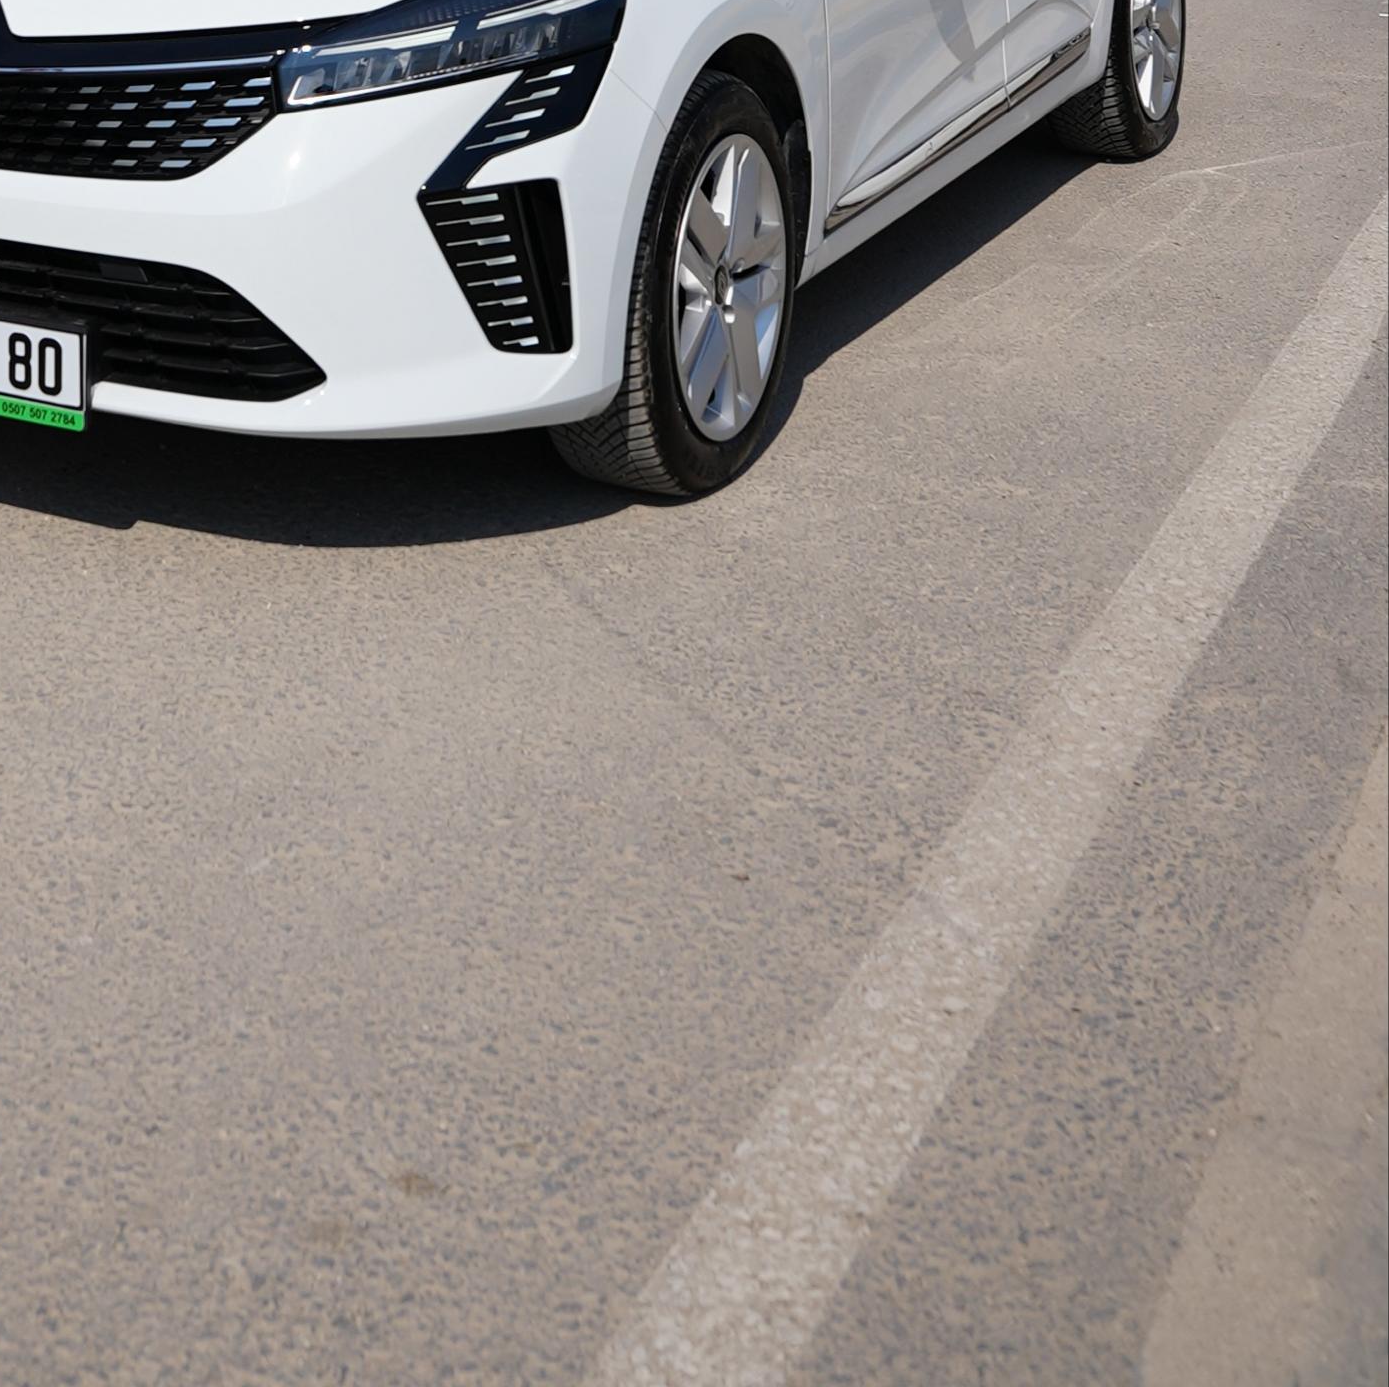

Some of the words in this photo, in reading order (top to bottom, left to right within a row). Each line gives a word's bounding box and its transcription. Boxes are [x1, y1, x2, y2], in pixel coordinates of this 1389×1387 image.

[8, 332, 63, 396] 80
[1, 401, 26, 416] 0507
[29, 407, 47, 420] 507
[50, 411, 75, 427] 2784
